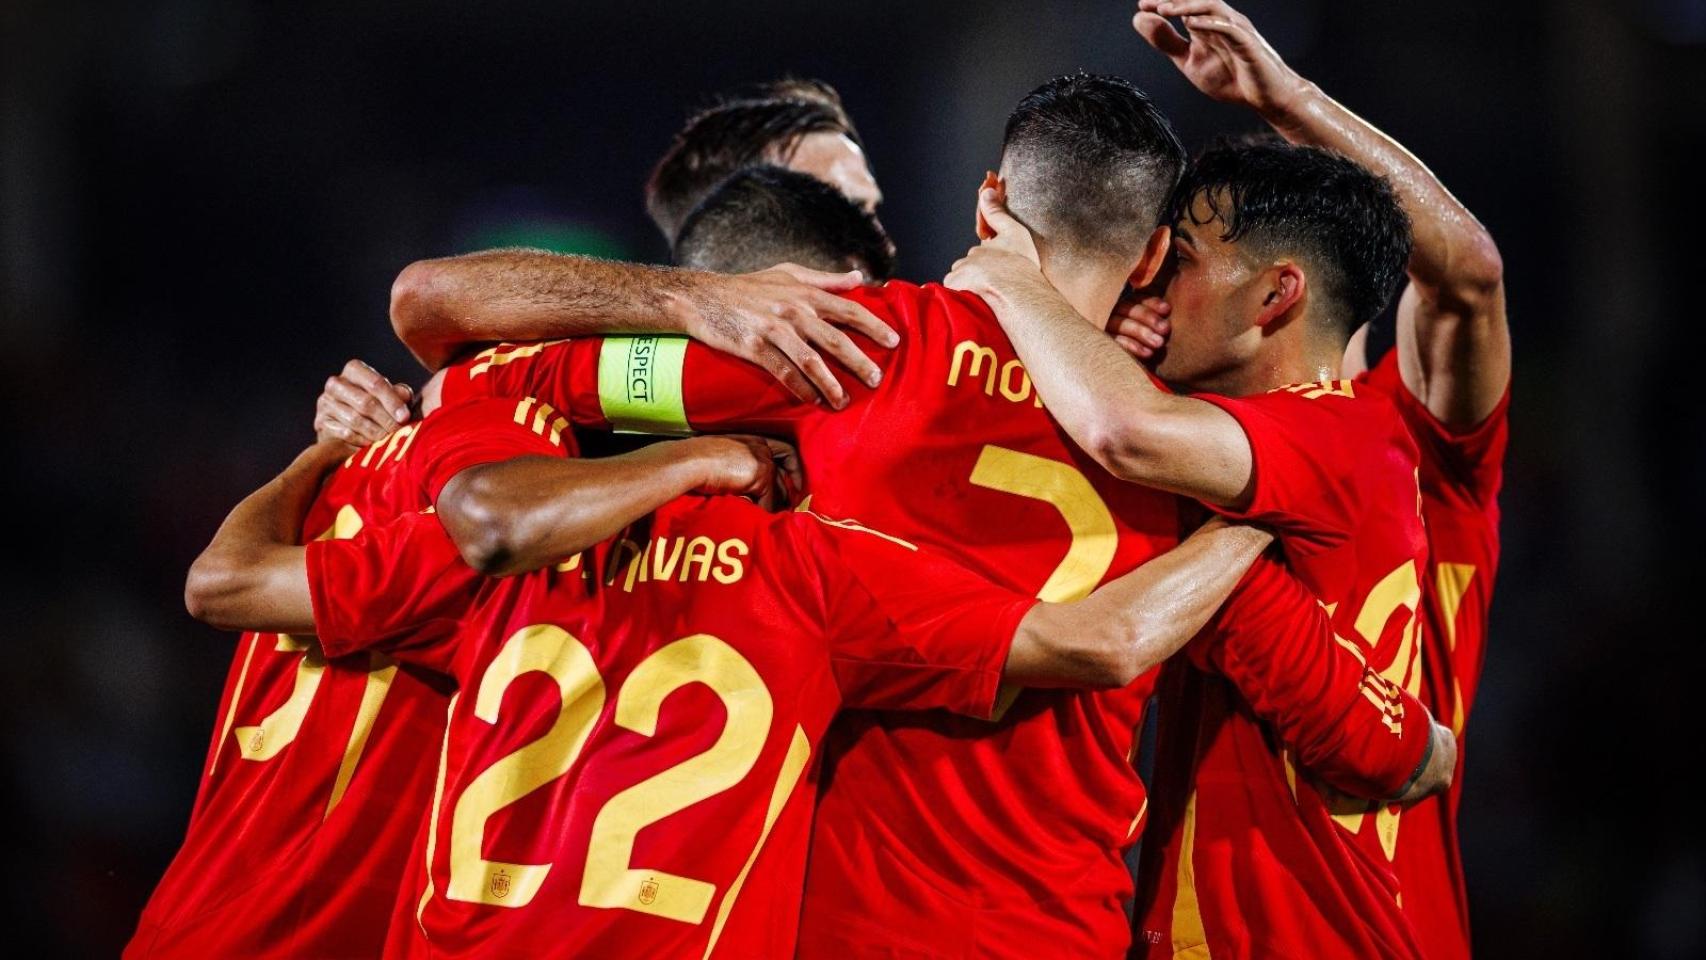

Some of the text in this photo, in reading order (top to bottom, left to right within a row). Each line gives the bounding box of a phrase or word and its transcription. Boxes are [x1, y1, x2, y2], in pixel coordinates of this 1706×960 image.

[632, 335, 651, 403] ESPECT
[947, 340, 1043, 409] MO
[446, 623, 774, 925] 22
